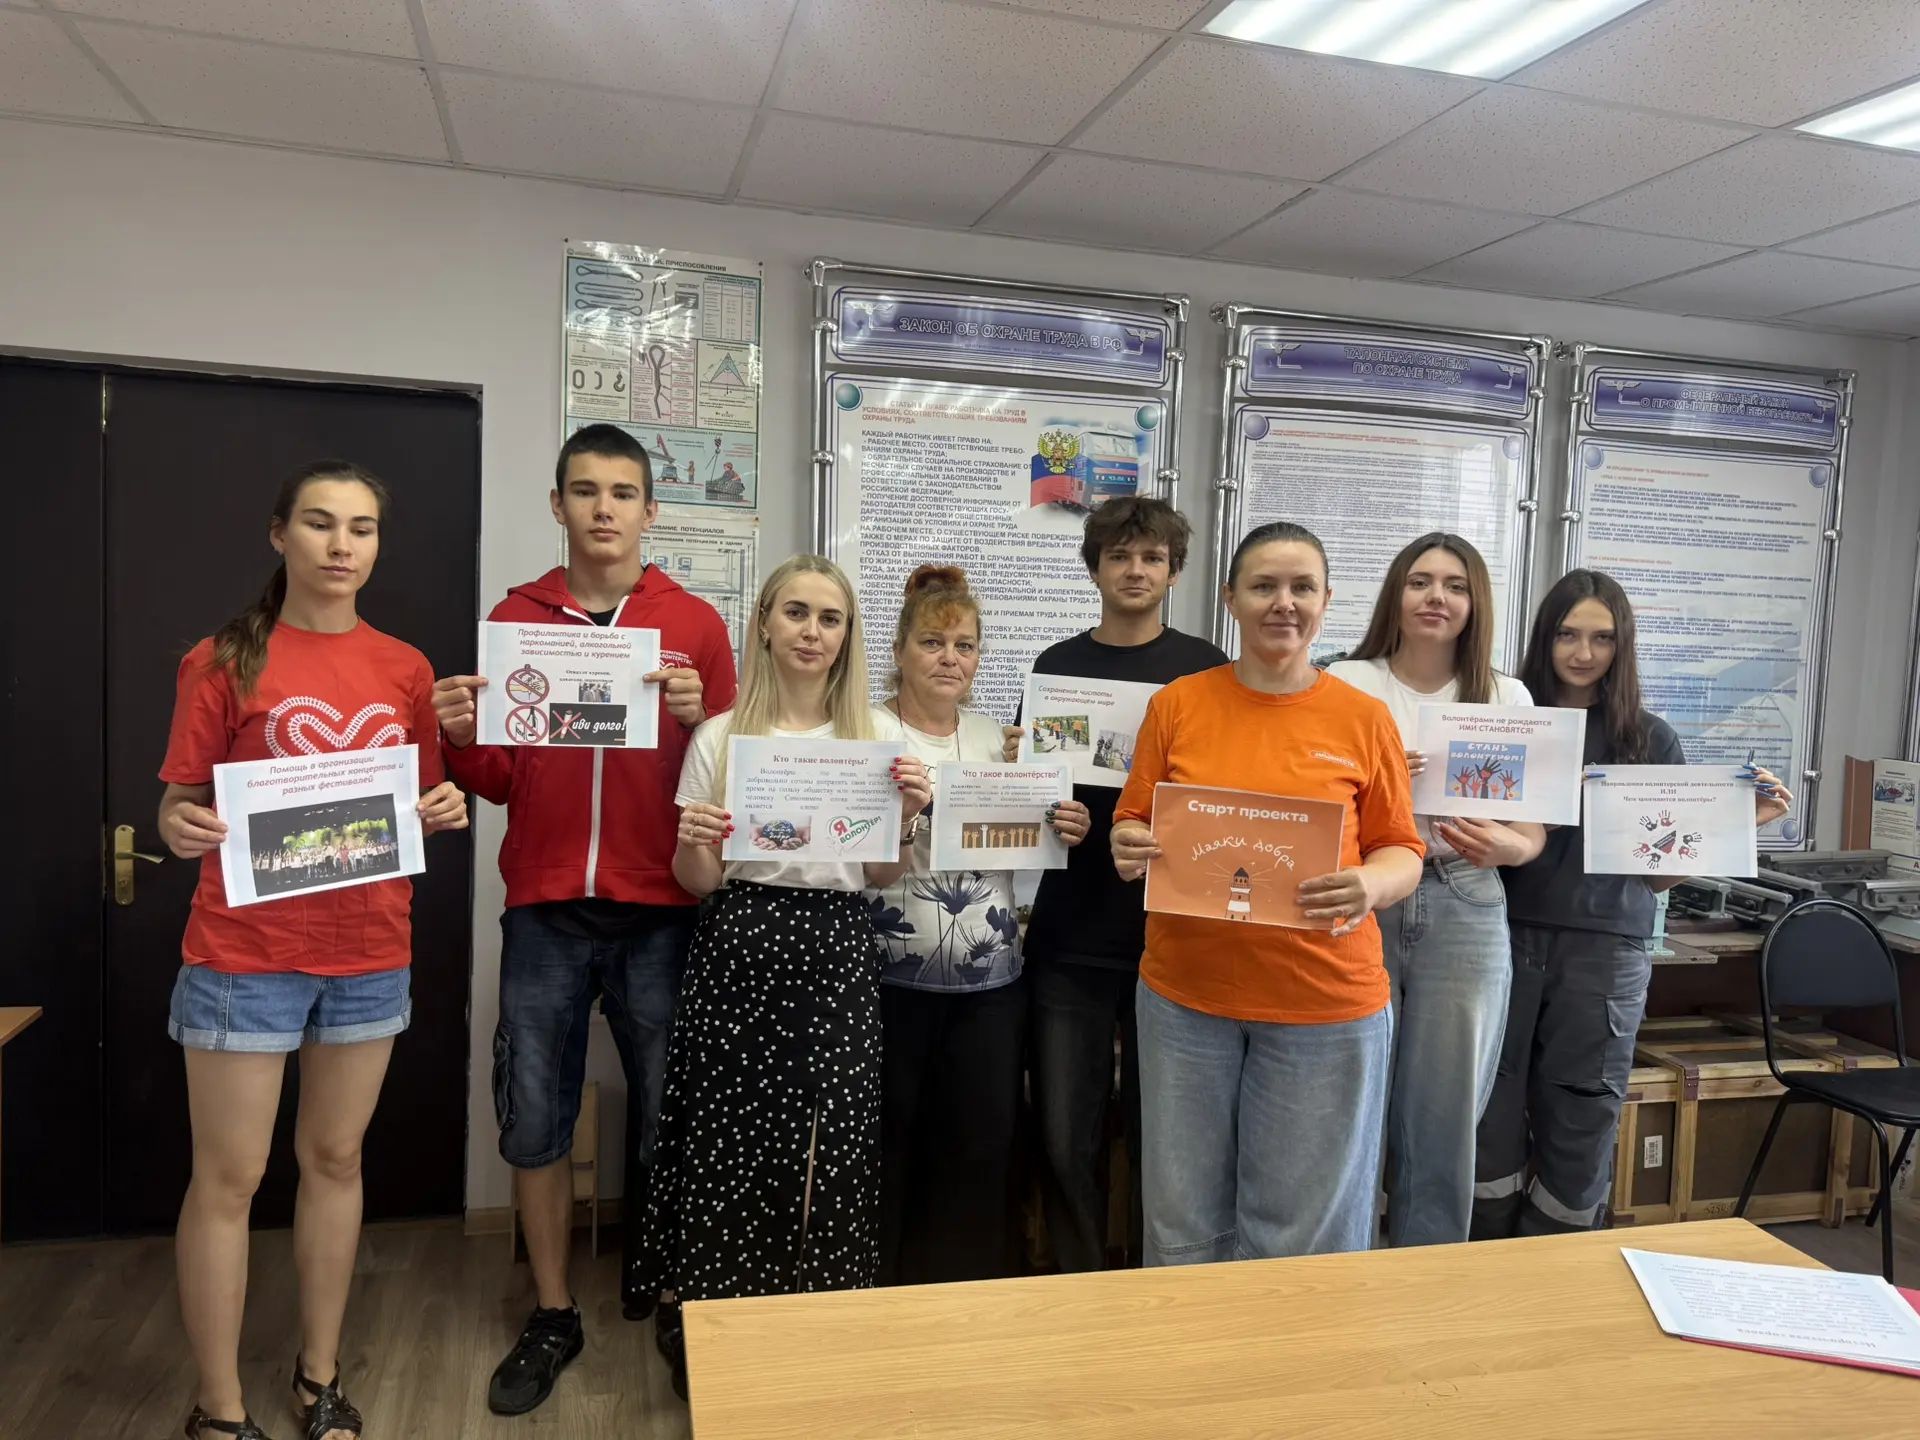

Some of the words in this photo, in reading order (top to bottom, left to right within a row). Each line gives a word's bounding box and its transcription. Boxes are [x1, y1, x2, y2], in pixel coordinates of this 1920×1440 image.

[665, 259, 727, 272] ПРИСПОСОБЛЕНИЯ
[899, 318, 951, 334] ЗАКОН
[956, 321, 978, 336] ОБ
[981, 324, 1040, 342] ОХРАНЕ
[1043, 331, 1088, 349] ТРУДА
[1091, 336, 1100, 349] В
[1103, 337, 1122, 351] РФ
[1344, 347, 1413, 364] ТАЛОННАЯ
[1417, 352, 1471, 370] СИСТЕМА
[1353, 361, 1373, 374] ПО
[1375, 363, 1424, 379] ОХРАНЕ
[1426, 368, 1462, 384] ТРУДА
[1680, 389, 1758, 406] ФЕДЕРАЛЬНЫЙ
[1641, 398, 1651, 408] О
[1651, 398, 1745, 416] ПРОМЫШЛЕННОЙ
[861, 430, 892, 438] КАЖДЫЙ
[894, 432, 930, 441] РАБОТНИК
[932, 435, 955, 443] ИМЕЕТ
[861, 445, 890, 453] ВАНИЯМ
[892, 447, 922, 455] ОХРАНЫ
[868, 437, 900, 445] РАБОЧЕЕ
[928, 441, 999, 452] СООТВЕТСТВУЮЩЕЕ
[867, 453, 921, 463] ОБЯЗАТЕЛЬНОЕ
[924, 457, 972, 466] СОЦИАЛЬНОЕ
[973, 460, 1022, 469] СТРАХОВАНИЕ
[861, 460, 909, 470] НЕСЧАСТНЫХ
[910, 463, 942, 472] СЛУЧАЕВ
[955, 466, 1008, 476] ПРОИЗВОДСТВЕ
[861, 468, 939, 479] ПРОФЕССИОНАЛЬНЫХ
[941, 473, 991, 482] ЗАБОЛЕВАНИЙ
[861, 476, 916, 485] СООТВЕТСТВИИ
[925, 480, 1001, 490] ЗАКОНОДАТЕЛЬСТВОМ
[861, 484, 908, 493] РОССИЙСКОЙ
[866, 492, 908, 500] ПОЛУЧЕНИЕ
[910, 494, 961, 503] ДОСТОВЕРНОЙ
[963, 497, 1010, 506] ИНФОРМАЦИИ
[861, 500, 915, 509] РАБОТОДАТЕЛЯ
[917, 503, 987, 513] СООТВЕТСТВУЮЩИХ
[861, 508, 912, 517] ДАРСТВЕННЫХ
[914, 511, 947, 519] ОРГАНОВ
[861, 515, 910, 524] ОРГАНИЗАЦИЙ
[680, 526, 725, 534] ПОТЕНЦИАЛОВ
[872, 525, 907, 533] РАБОЧЕМ
[943, 528, 1005, 537] СУЩЕСТВУЮЩЕМ
[1031, 533, 1083, 541] ПОВРЕЖДЕНИЯ
[861, 532, 882, 540] ТАКЖЕ
[893, 534, 917, 542] МЕРАХ
[931, 536, 960, 544] ЗАЩИТЕ
[974, 538, 1025, 547] ВОЗДЕЙСТВИЯ
[1027, 540, 1060, 549] ВРЕДНЫХ
[861, 541, 939, 551] ПРОИЗВОДСТВЕННЫХ
[866, 548, 889, 556] ОТКАЗ
[903, 550, 954, 559] ВЫПОЛНЕНИЯ
[1015, 555, 1076, 564] ВОЗНИКНОВЕНИЯ
[951, 560, 997, 569] ВСЛЕДСТВИЕ
[999, 562, 1041, 571] НАРУШЕНИЯ
[990, 570, 1060, 579] ПРЕДУСМОТРЕННЫХ
[981, 593, 1037, 602] ТРЕБОВАНИЯМИ
[1044, 588, 1097, 597] КОЛЛЕКТИВНОЙ
[518, 628, 581, 639] Профилактика
[591, 629, 619, 641] борьба
[1043, 627, 1074, 635] СРЕДСТВ
[520, 639, 578, 649] наркоманией,
[580, 641, 631, 650] алкогольной
[521, 648, 582, 658] зависимостью
[591, 651, 630, 660] курением
[1038, 685, 1078, 695] Сохранение
[1080, 690, 1113, 698] чистоты
[1050, 696, 1096, 705] окружающем
[593, 718, 627, 733] долго!
[1442, 714, 1494, 725] Волонтёрами
[1508, 718, 1552, 727] рождаются
[1459, 724, 1477, 732] ИМИ
[1479, 725, 1534, 735] СТАНОВЯТСЯ!
[1467, 742, 1509, 752] СТАНЬ
[269, 764, 308, 776] Помощь
[318, 755, 375, 770] организации
[773, 755, 789, 763] Кто
[819, 756, 869, 766] волонтёры?
[247, 769, 345, 789] благотворительных
[347, 763, 396, 776] концертов
[962, 770, 977, 778] Что
[1004, 770, 1060, 779] волонтёрство?
[282, 784, 315, 796] разных
[318, 775, 374, 792] фестивалей
[1188, 800, 1236, 817] Старт
[1239, 808, 1309, 823] проекта
[833, 820, 848, 837] Я
[1191, 835, 1247, 862] Маяки
[1252, 839, 1295, 872] добра
